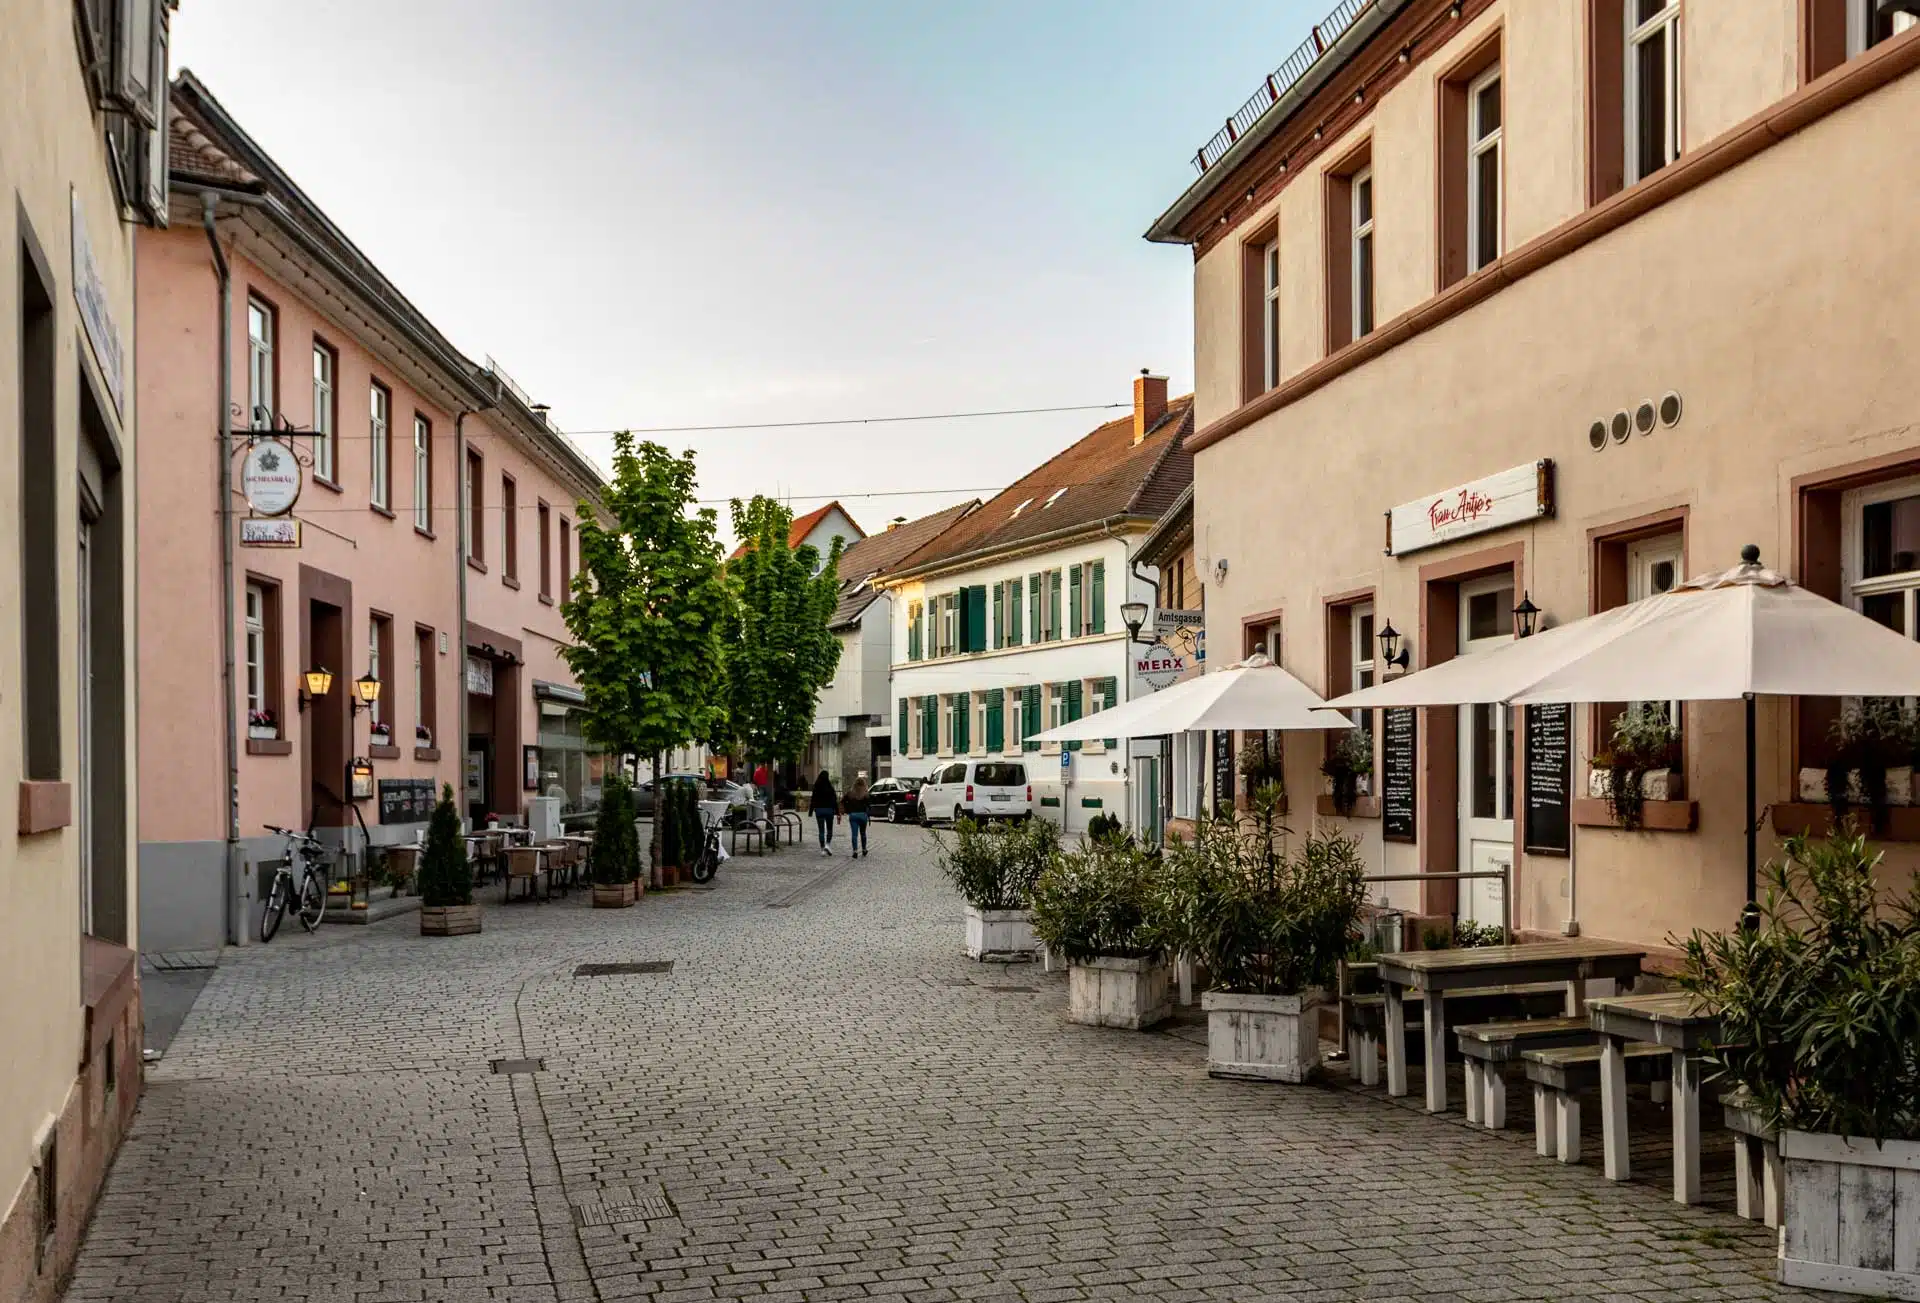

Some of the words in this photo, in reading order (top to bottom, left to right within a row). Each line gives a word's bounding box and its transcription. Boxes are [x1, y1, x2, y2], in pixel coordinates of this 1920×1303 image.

[1427, 499, 1451, 531] Frau
[1451, 489, 1492, 522] Antje's
[1158, 611, 1202, 625] Amtsgasse
[1137, 658, 1183, 671] MERX
[1063, 752, 1069, 765] P
